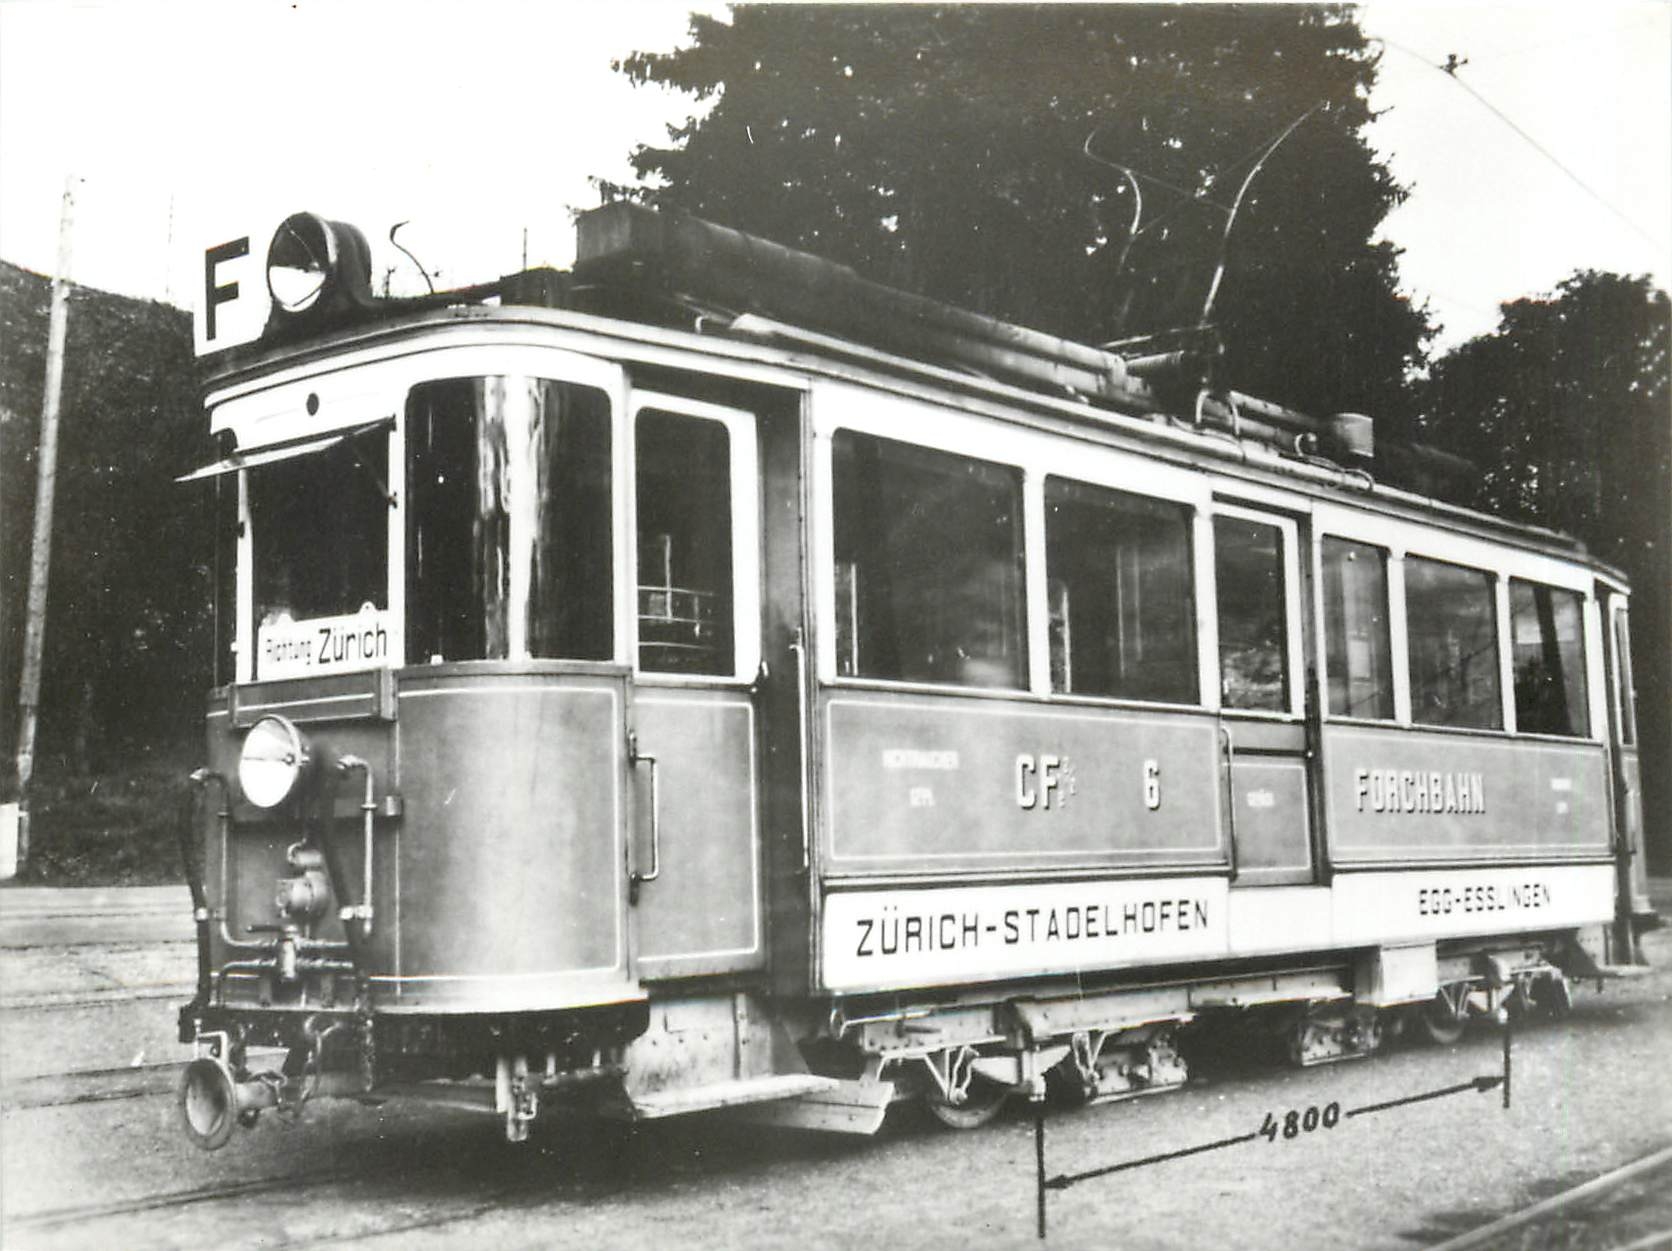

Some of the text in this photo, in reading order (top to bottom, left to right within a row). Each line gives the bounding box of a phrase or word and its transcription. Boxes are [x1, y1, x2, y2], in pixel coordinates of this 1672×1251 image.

[205, 235, 250, 342] F
[318, 622, 388, 665] Zürich
[1143, 758, 1161, 812] 6
[1356, 768, 1487, 815] FORCHBAHN
[1419, 882, 1552, 916] EGG-ESSLINGEN
[855, 898, 1209, 958] ZÜRICH-STADELHOFEN
